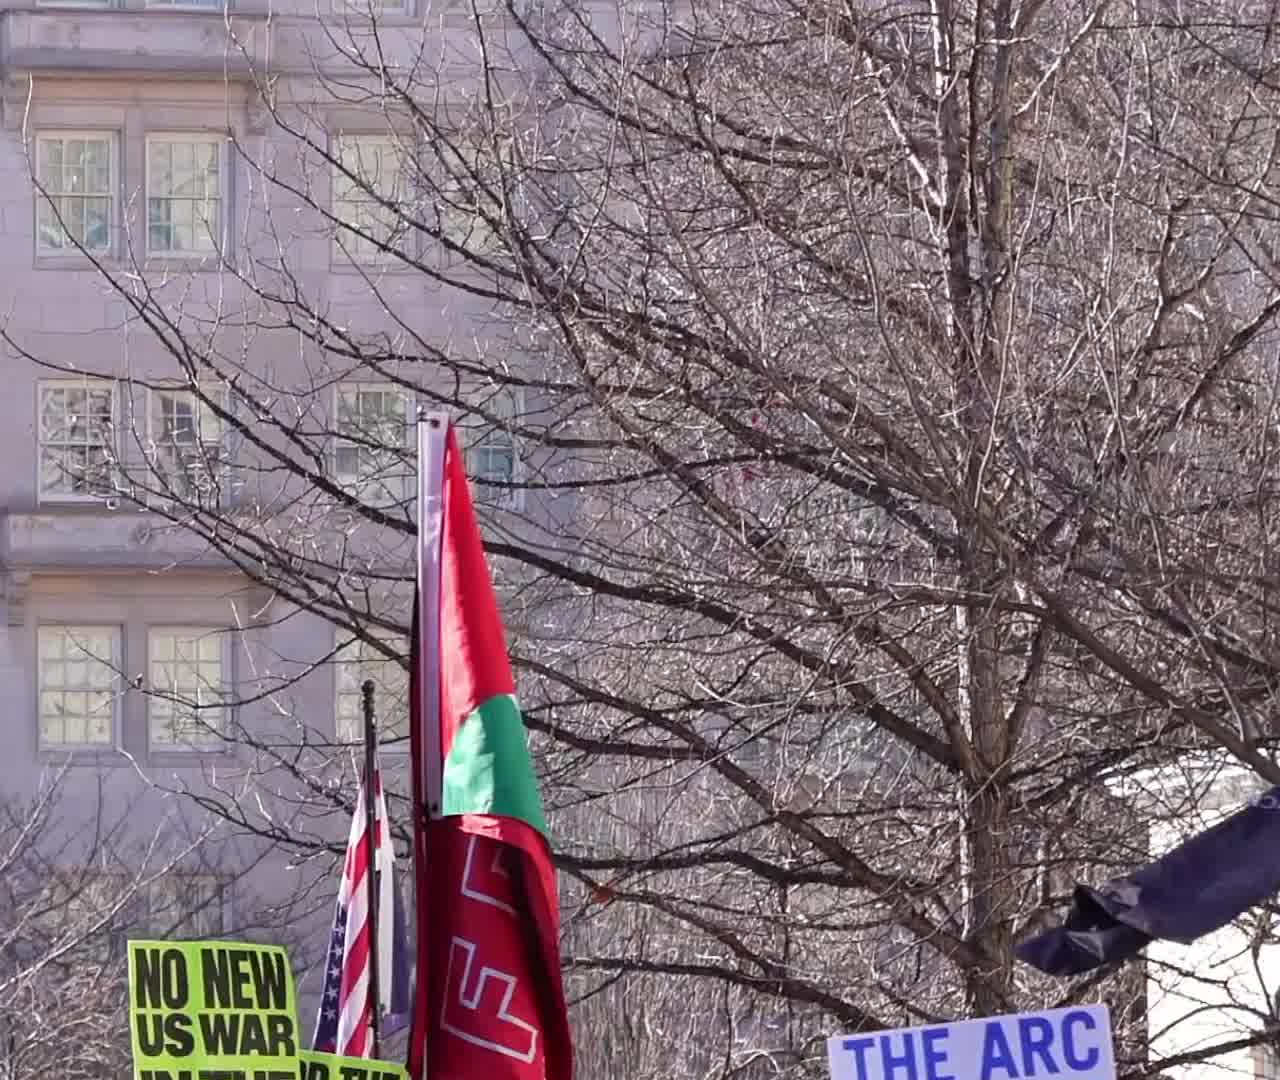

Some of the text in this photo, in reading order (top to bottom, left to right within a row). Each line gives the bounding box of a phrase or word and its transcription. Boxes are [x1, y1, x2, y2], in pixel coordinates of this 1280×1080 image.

[135, 948, 287, 1010] NO NEW
[136, 1013, 296, 1057] US WAR
